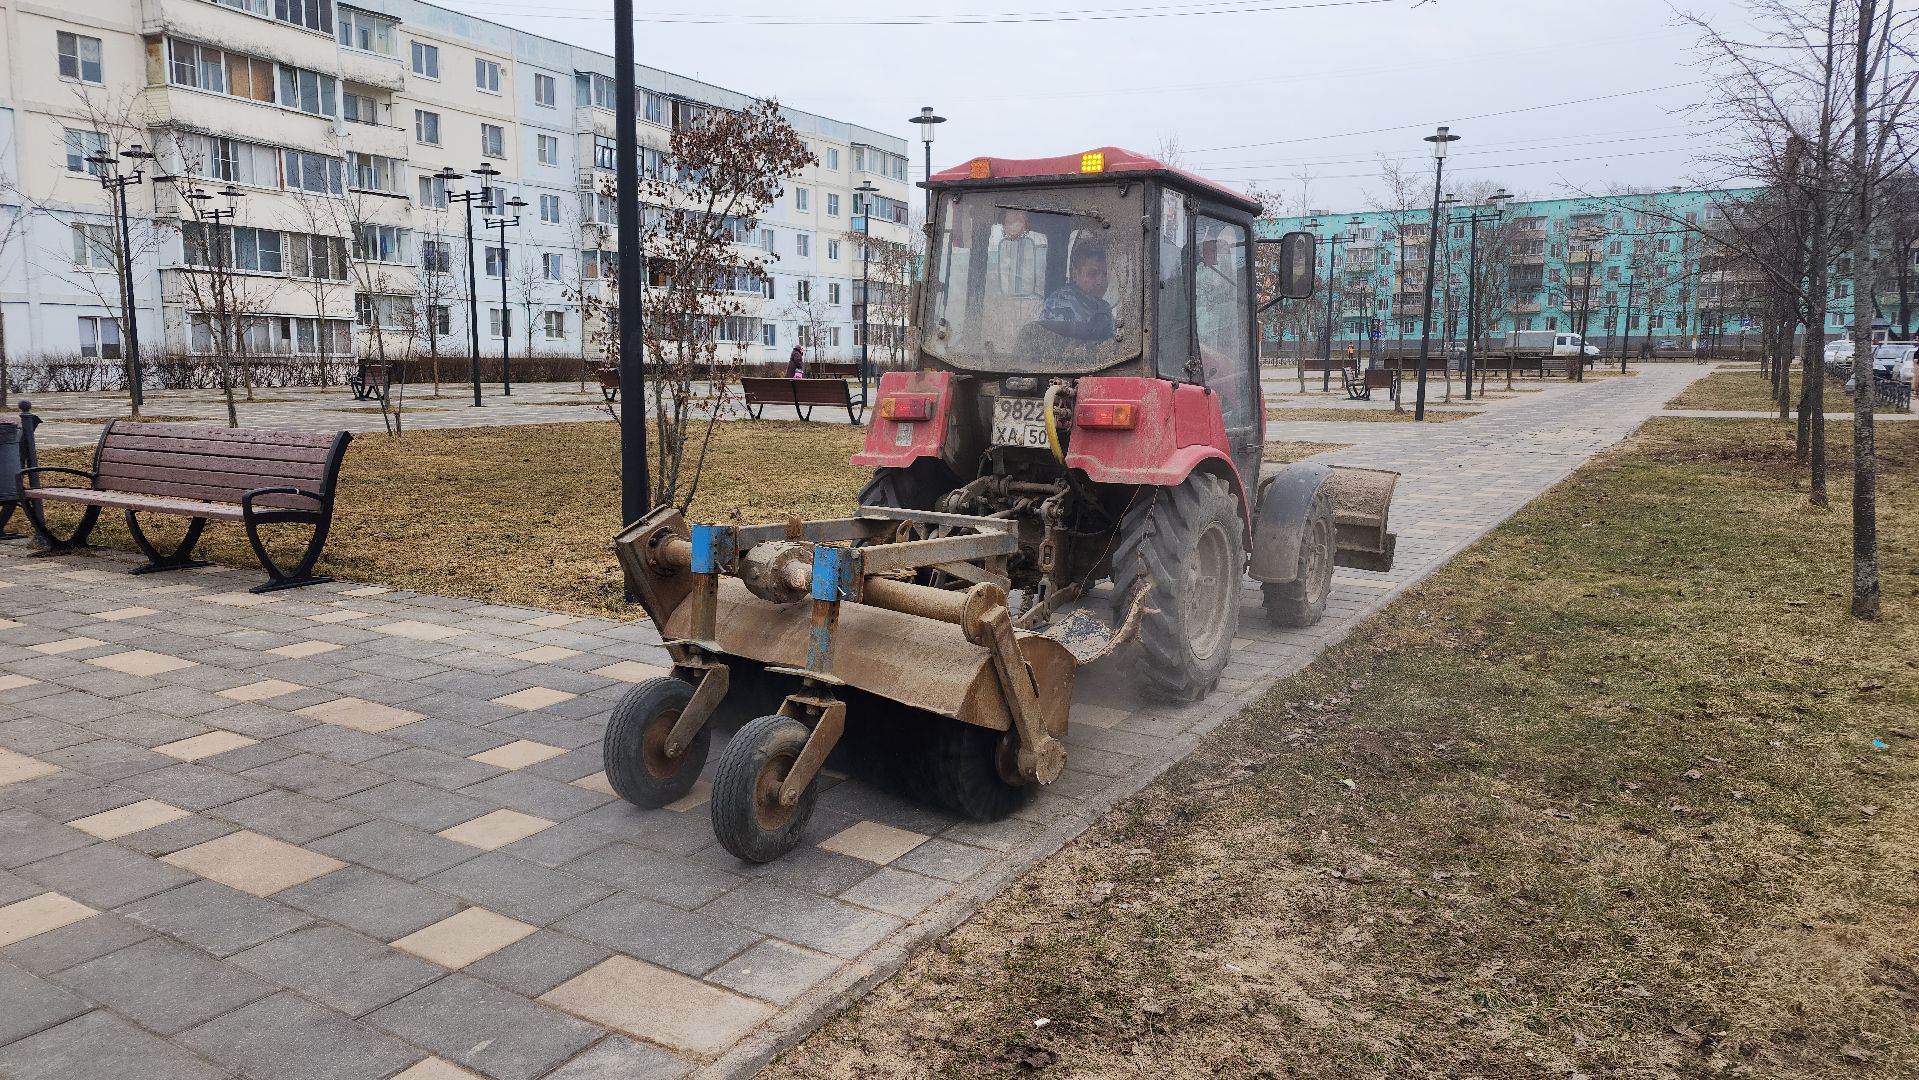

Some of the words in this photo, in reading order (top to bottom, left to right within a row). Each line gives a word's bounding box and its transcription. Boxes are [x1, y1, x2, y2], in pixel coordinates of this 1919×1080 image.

[1000, 400, 1045, 421] 9822
[996, 427, 1018, 444] ХА
[1028, 429, 1048, 444] 50
